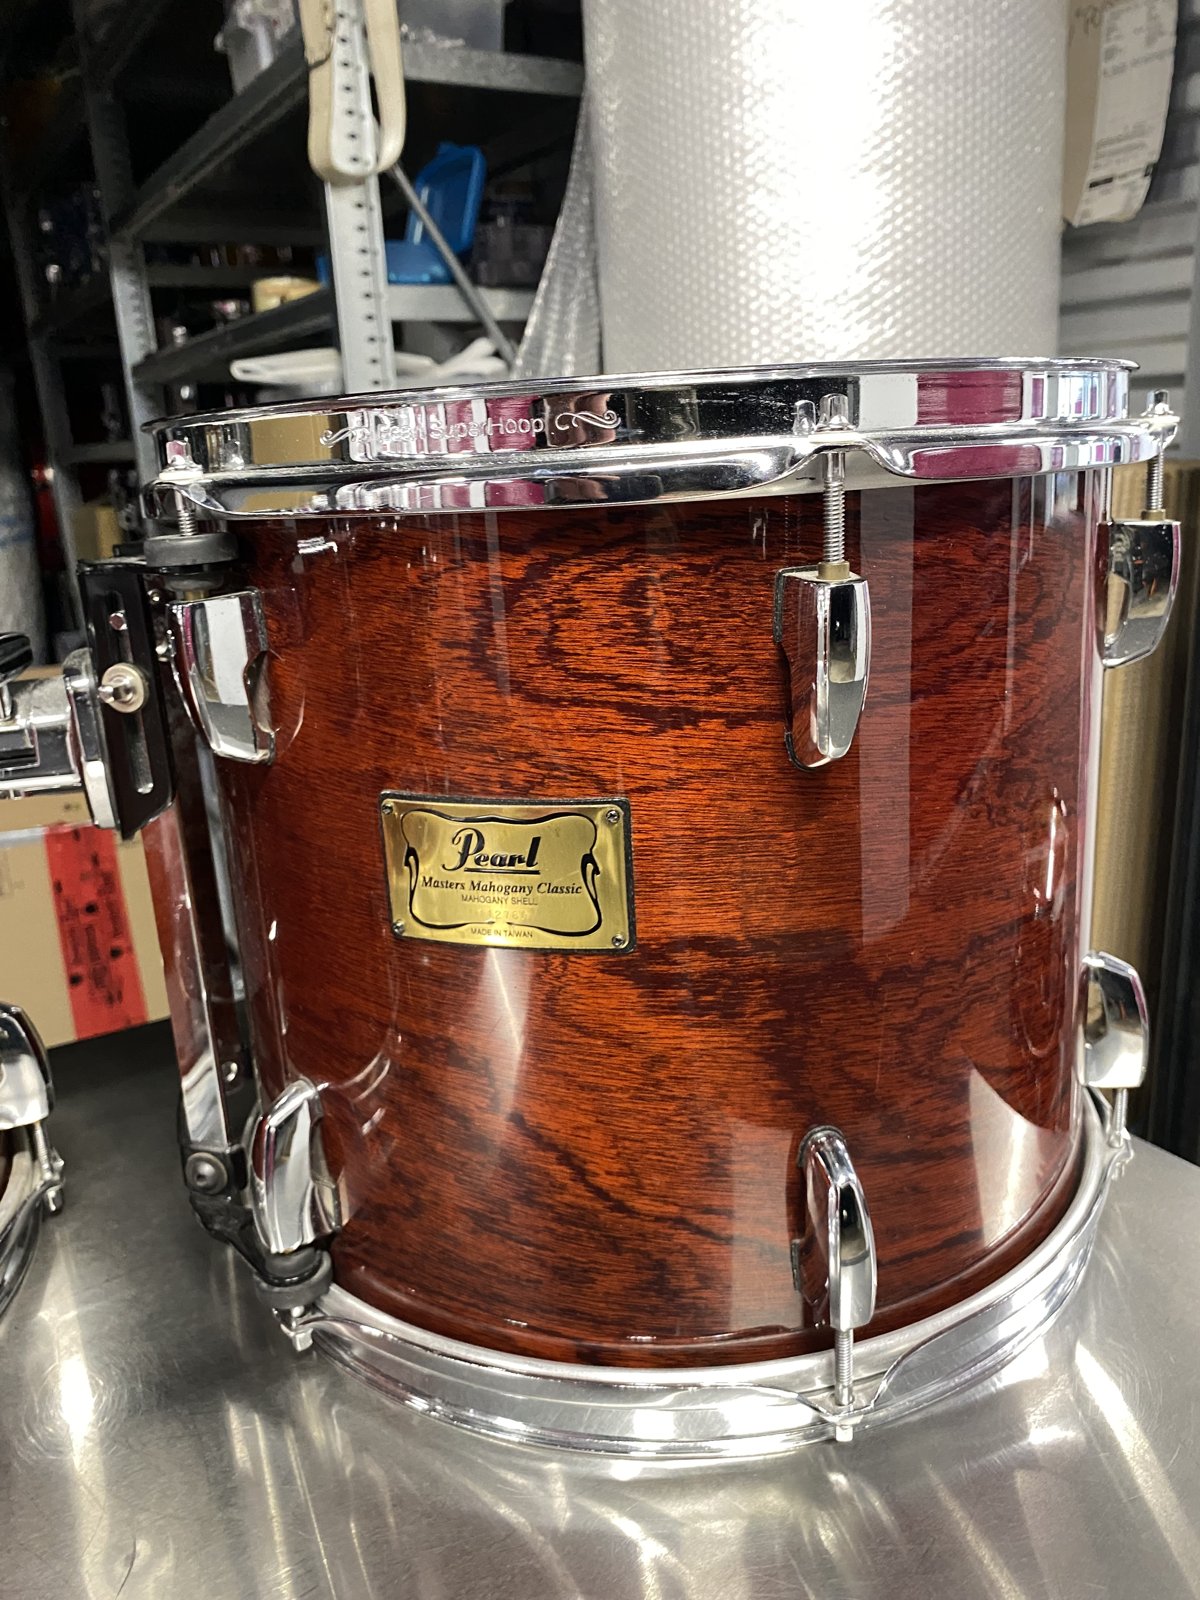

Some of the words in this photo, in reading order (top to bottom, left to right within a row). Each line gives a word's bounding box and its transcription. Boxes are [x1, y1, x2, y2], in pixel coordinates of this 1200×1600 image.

[442, 827, 542, 875] Pearl
[421, 876, 466, 890] Masters
[468, 880, 534, 896] Mahogany
[536, 882, 583, 895] Classic
[461, 894, 509, 904] MAHOGANY
[511, 896, 538, 906] SHELL
[471, 927, 492, 936] MADE
[503, 930, 533, 938] TAIWAN
